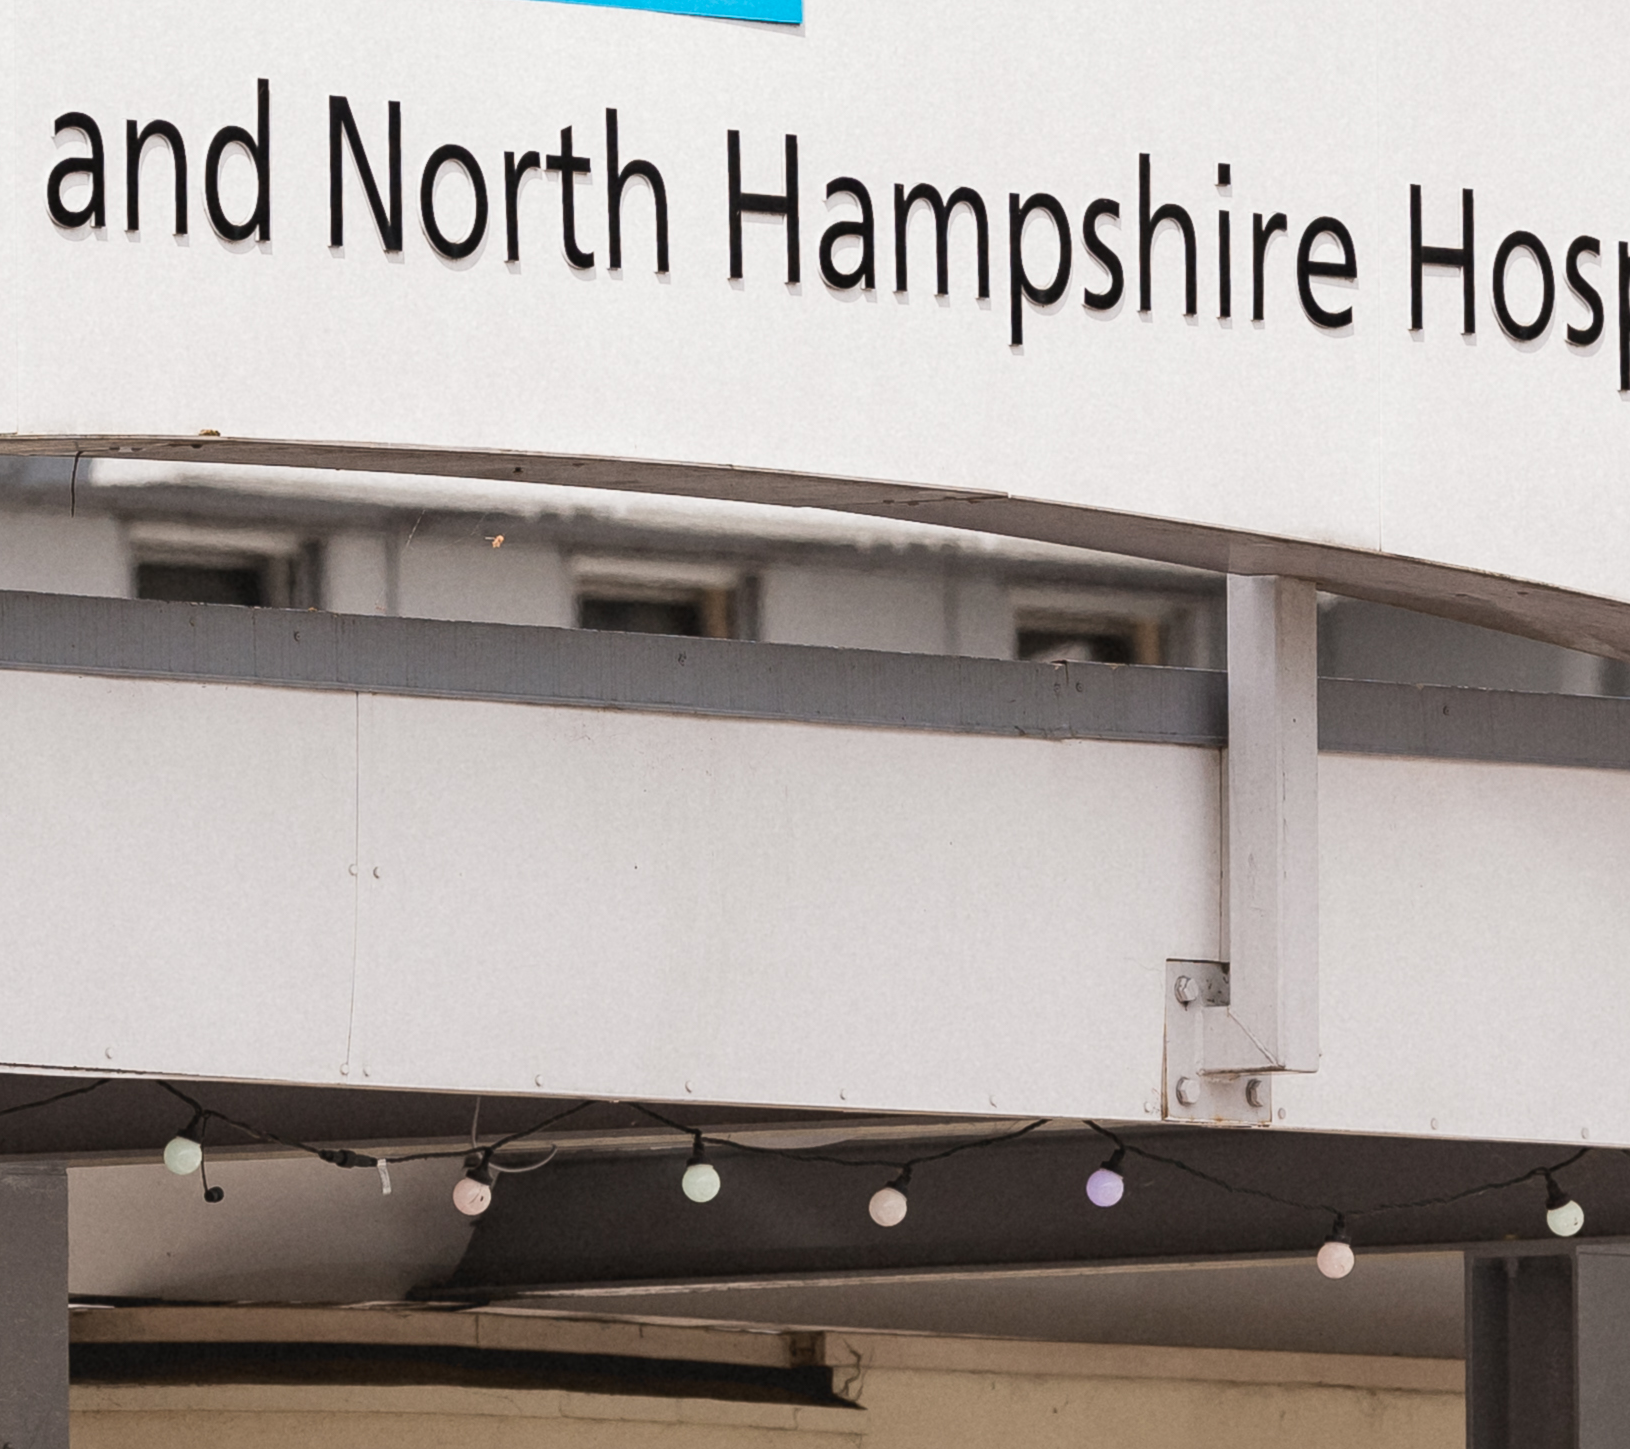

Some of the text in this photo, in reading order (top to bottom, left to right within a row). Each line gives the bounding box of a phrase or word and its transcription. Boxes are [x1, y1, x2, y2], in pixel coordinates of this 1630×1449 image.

[47, 78, 272, 243] and
[329, 95, 670, 274] North
[727, 129, 1358, 347] Hampshire
